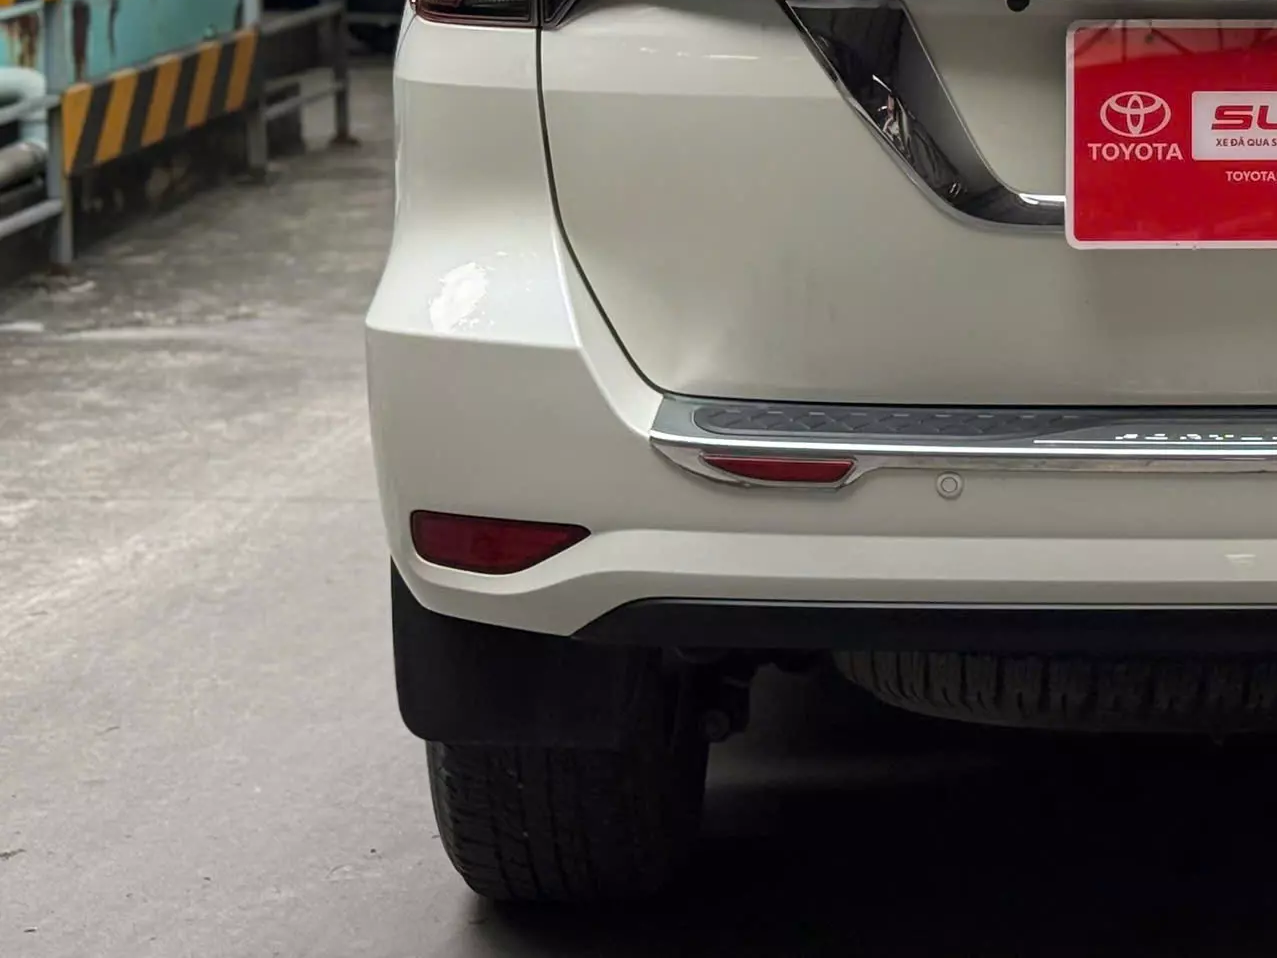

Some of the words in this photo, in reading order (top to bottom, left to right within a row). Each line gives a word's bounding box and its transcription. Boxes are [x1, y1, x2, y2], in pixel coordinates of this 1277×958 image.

[1216, 138, 1229, 147] XE
[1230, 136, 1245, 147] ĐÃ
[1247, 138, 1270, 147] QUA
[1087, 143, 1184, 161] TOYOTA
[1225, 170, 1276, 182] TOYOTA
